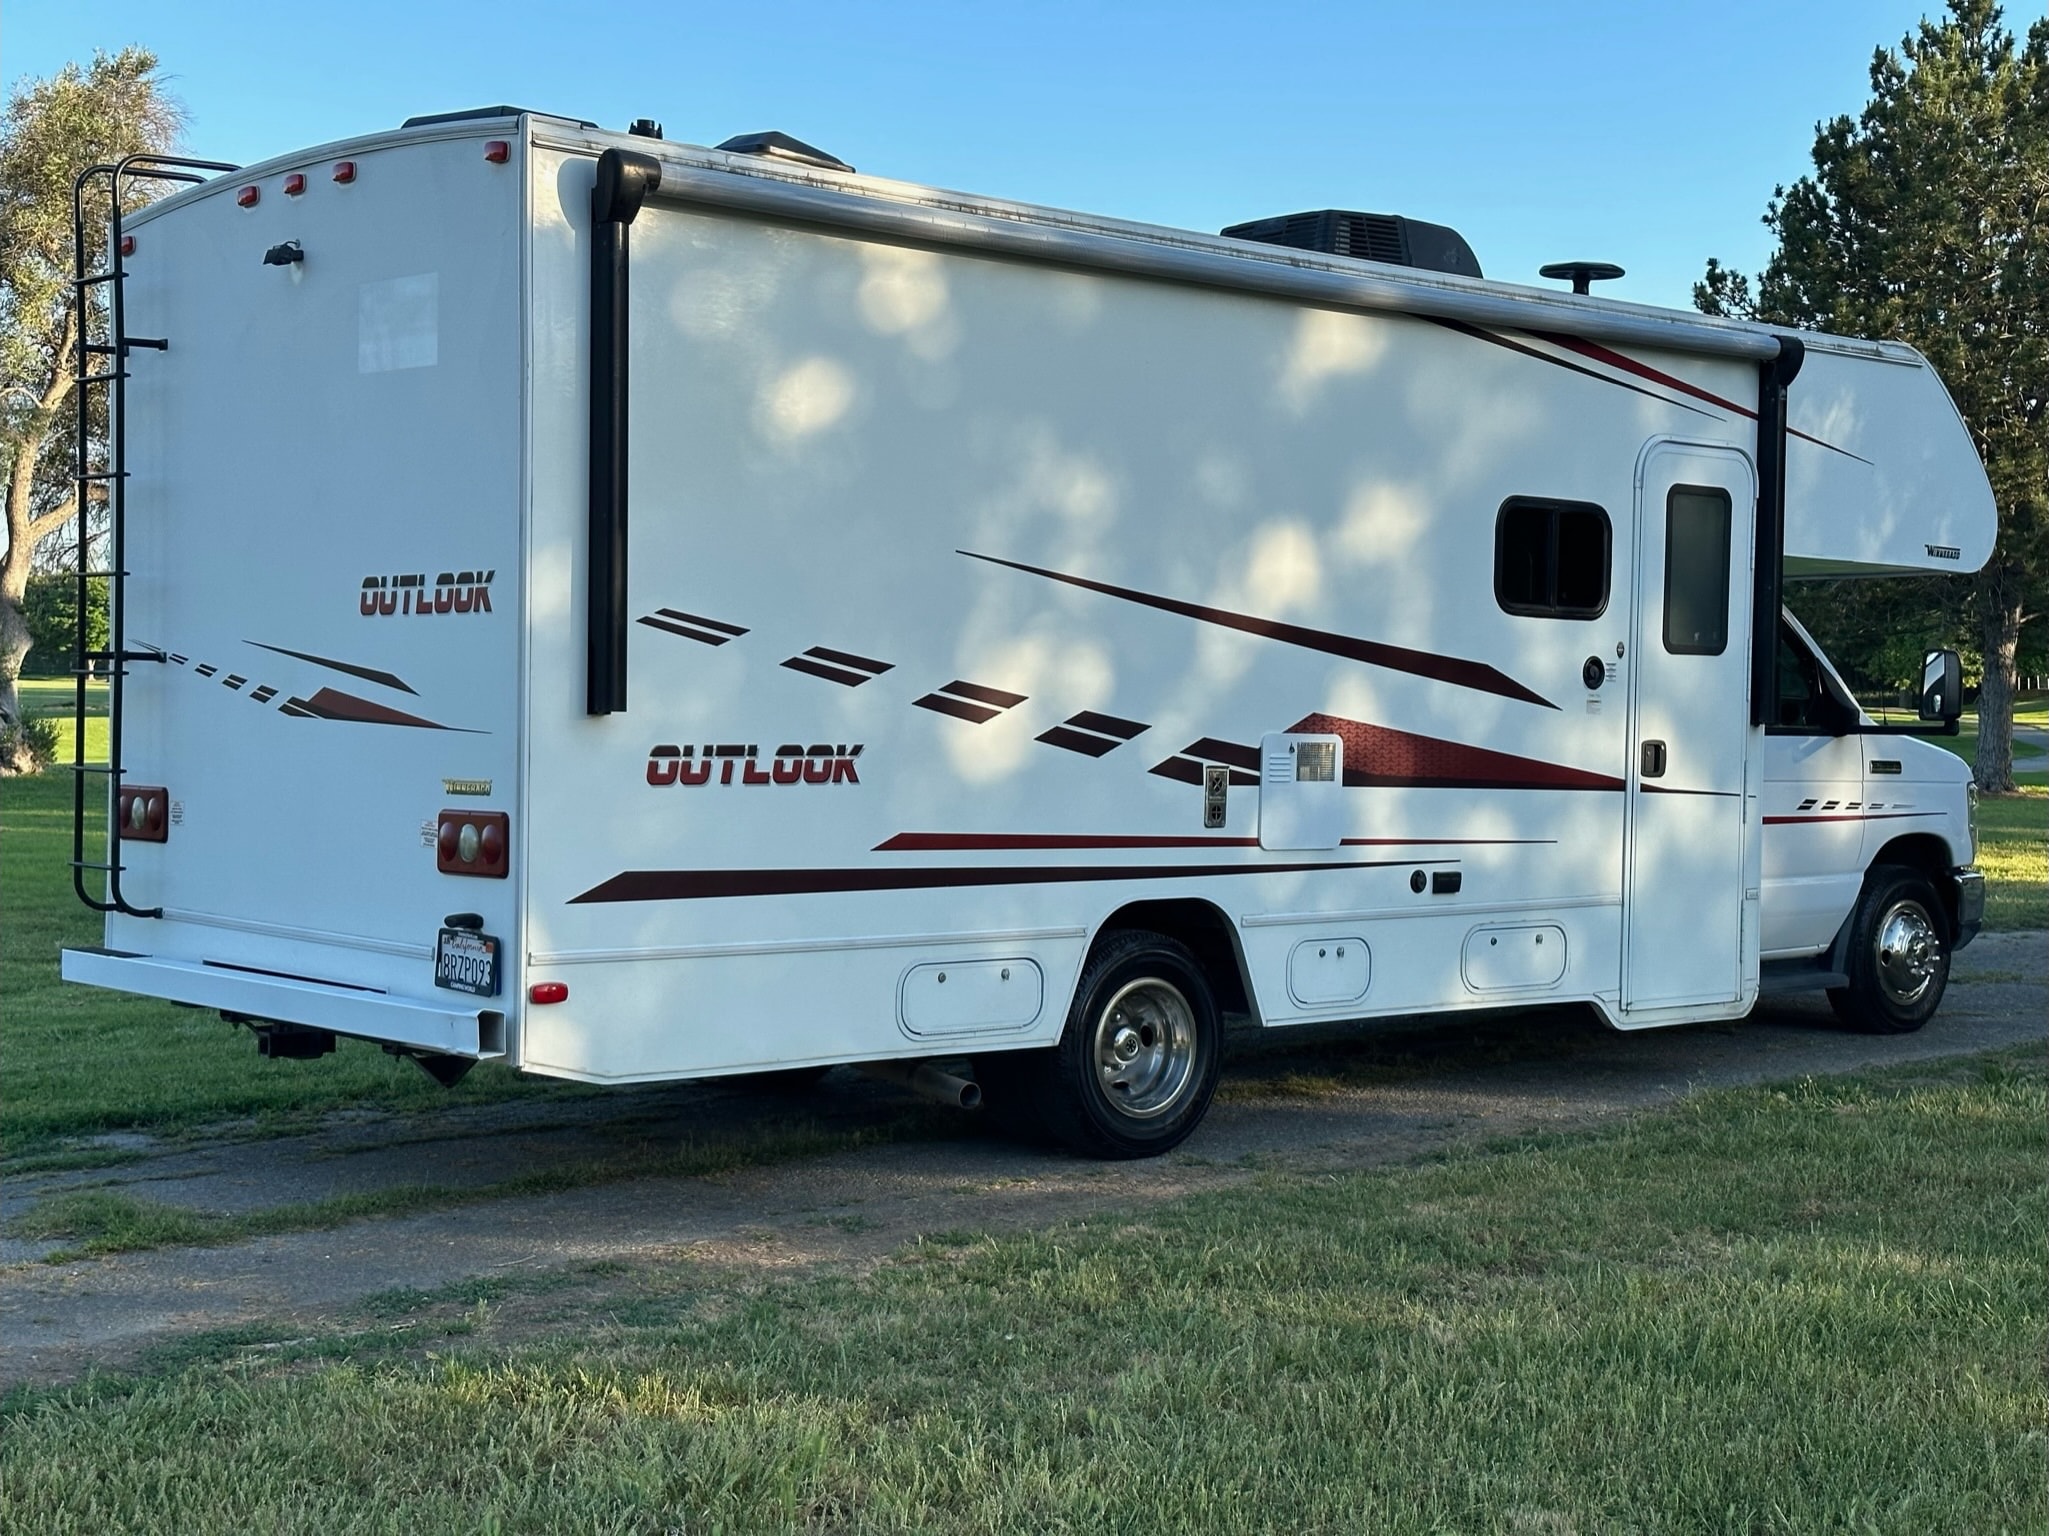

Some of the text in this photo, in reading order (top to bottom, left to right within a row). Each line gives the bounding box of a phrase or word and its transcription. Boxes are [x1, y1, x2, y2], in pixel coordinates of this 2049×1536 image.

[361, 569, 496, 616] OUTLOOK
[647, 744, 864, 786] OUTLOOK
[443, 953, 492, 987] 8RZP093
